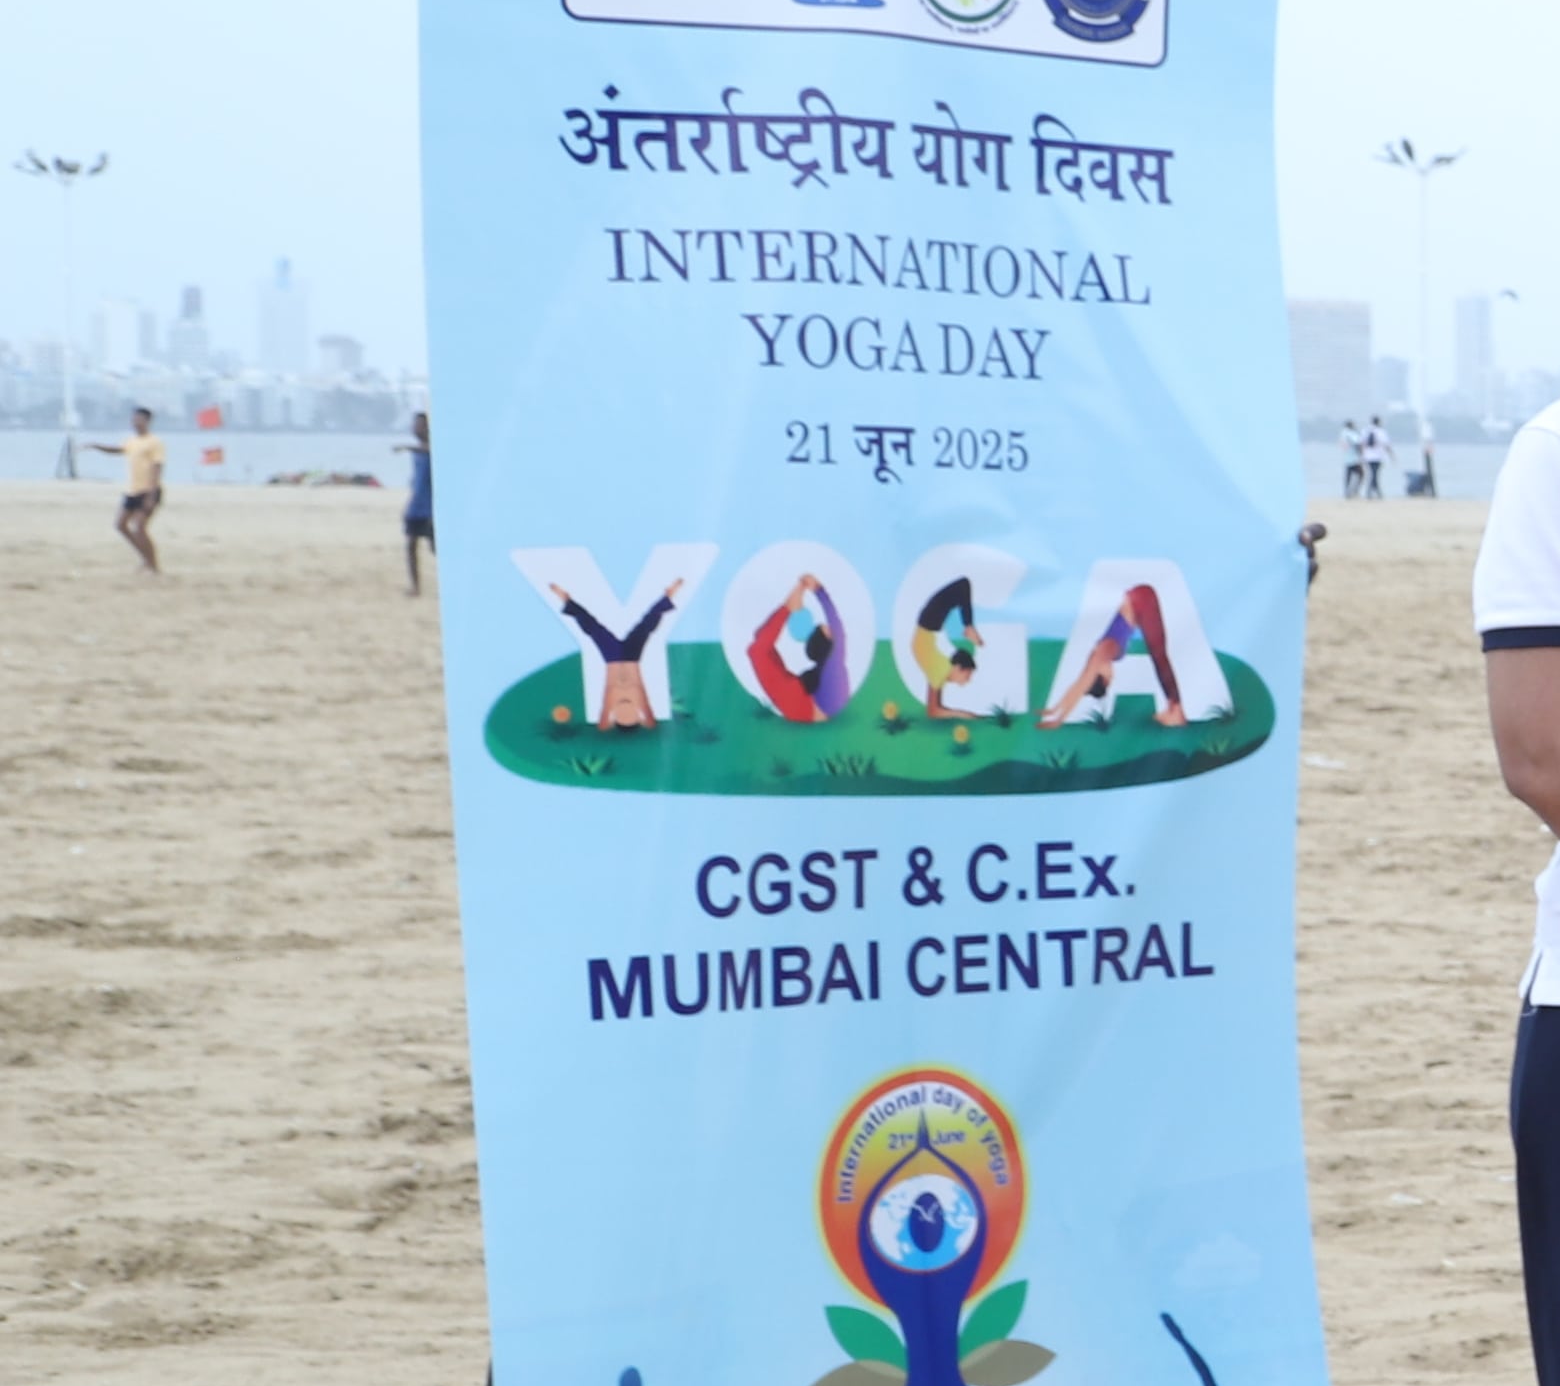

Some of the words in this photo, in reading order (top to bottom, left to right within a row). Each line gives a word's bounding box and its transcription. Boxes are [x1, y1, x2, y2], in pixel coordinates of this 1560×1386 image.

[559, 83, 895, 188] अंतर्राष्ट्रीय
[912, 100, 1013, 192] योग
[1030, 113, 1173, 205] दिवस
[603, 228, 1152, 305] INTERNATIONAL
[741, 313, 928, 375] YOGA
[940, 321, 1052, 380] DAY
[785, 420, 838, 465] 21
[853, 425, 916, 485] जून
[933, 428, 1029, 473] 2025
[509, 539, 1236, 725] YOGA
[695, 849, 878, 919] CGST
[901, 845, 944, 908] &
[966, 841, 1136, 904] C.Ex.
[586, 940, 880, 1021] MUMBAI
[906, 921, 1215, 999] CENTRAL
[836, 1085, 927, 1203] International
[932, 1087, 966, 1119] day
[966, 1105, 990, 1128] of
[980, 1129, 1010, 1187] yoga
[931, 1128, 966, 1146] June
